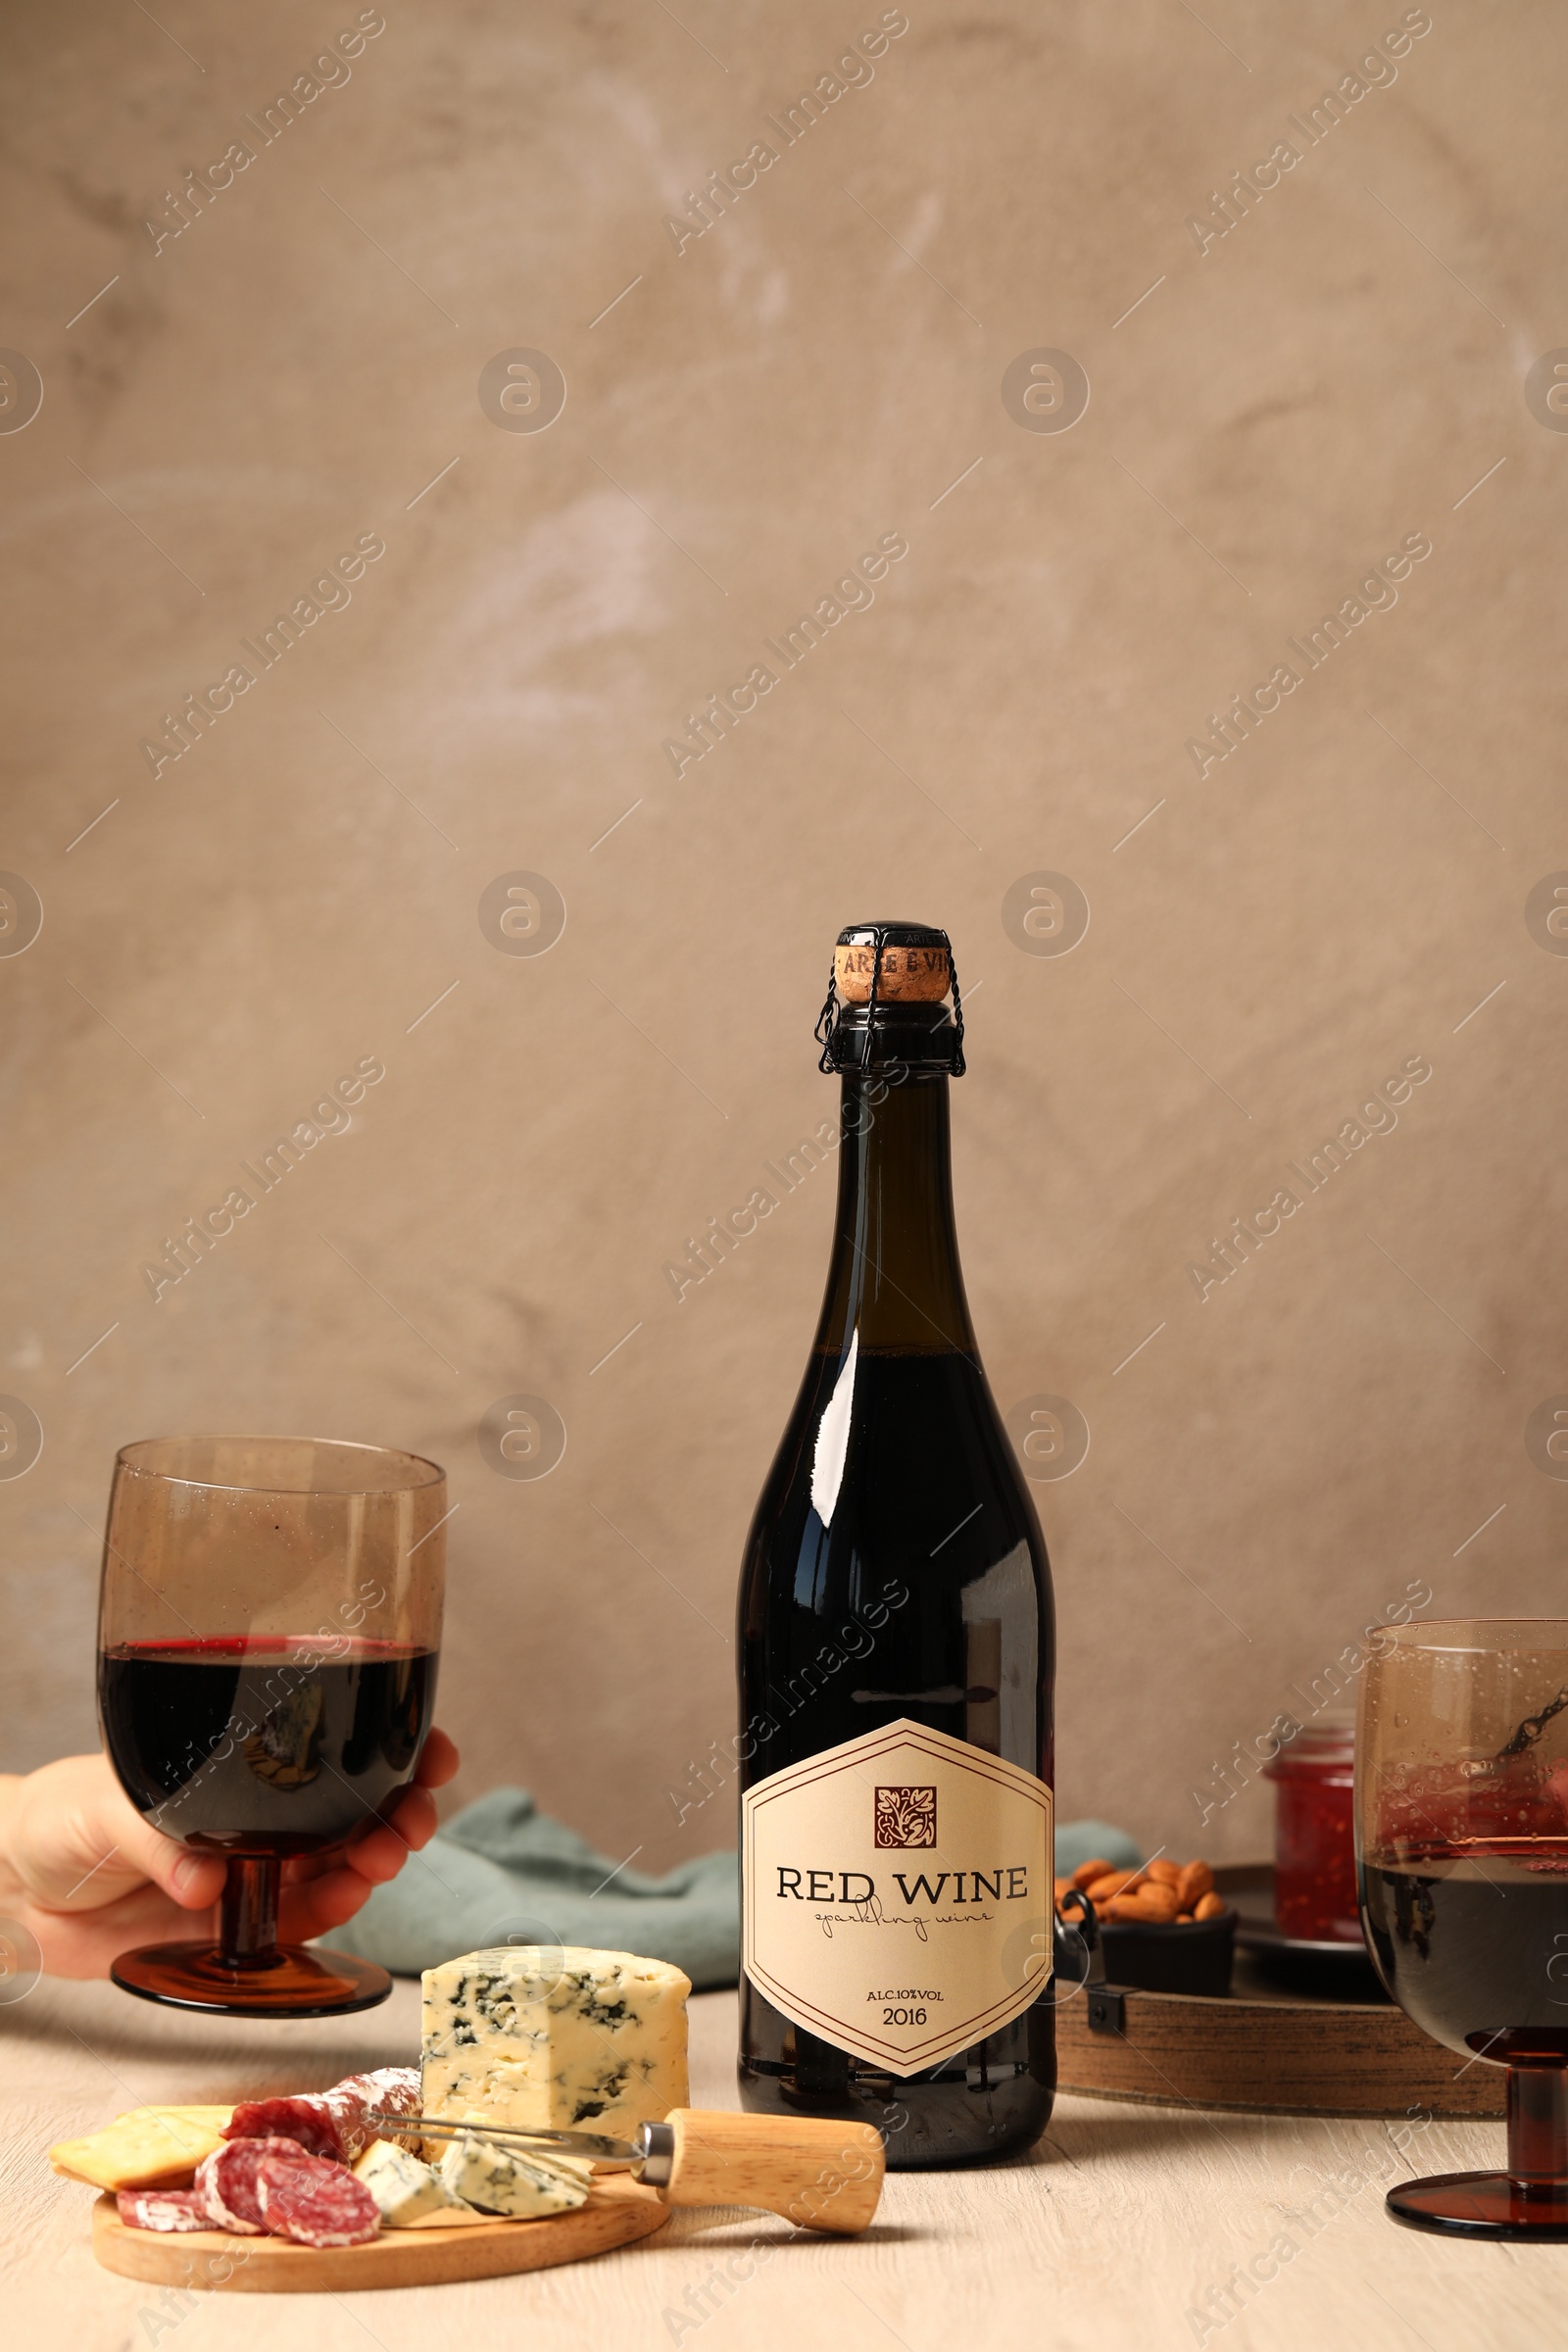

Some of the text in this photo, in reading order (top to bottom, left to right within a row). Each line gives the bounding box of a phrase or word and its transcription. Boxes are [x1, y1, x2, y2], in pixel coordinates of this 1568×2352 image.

[844, 952, 897, 973] ARE
[776, 1866, 1028, 1905] RED WINE
[813, 1893, 994, 1941] sparkling wine
[883, 2008, 927, 2026] 2016
